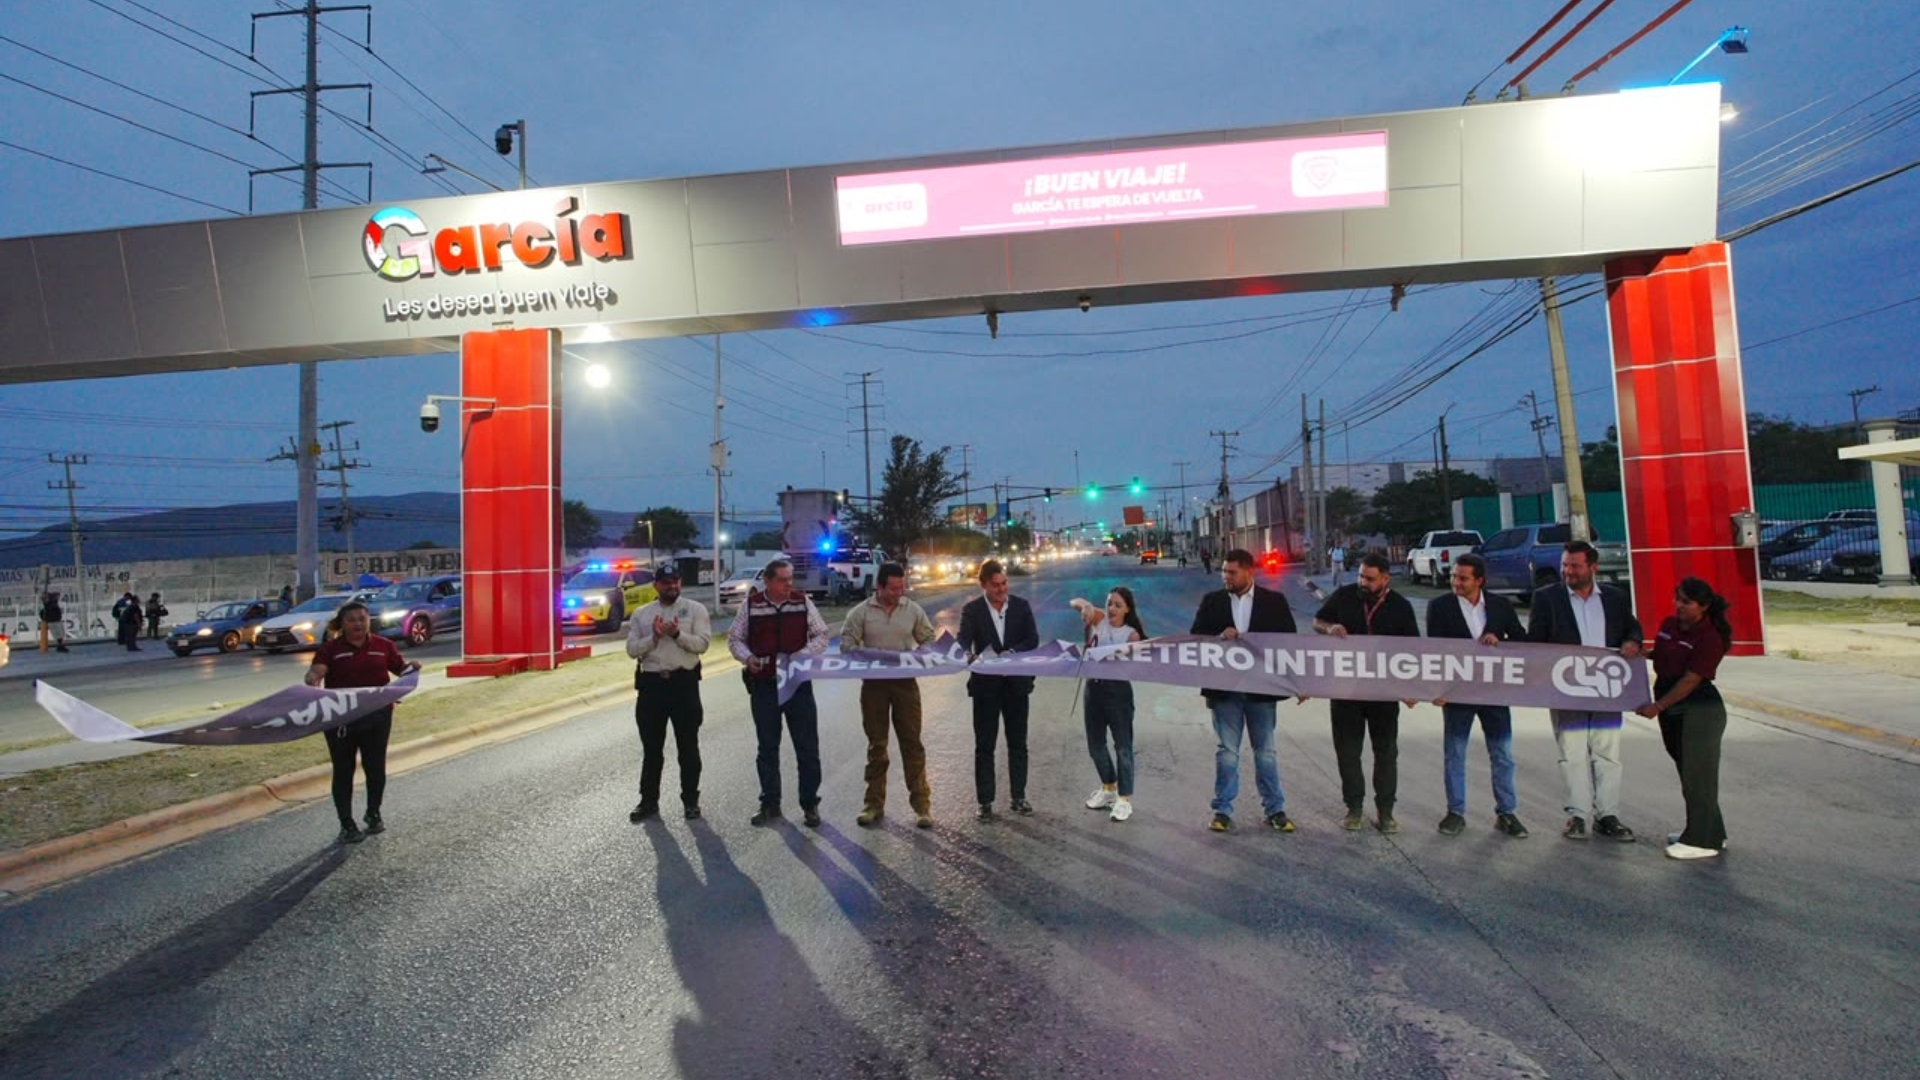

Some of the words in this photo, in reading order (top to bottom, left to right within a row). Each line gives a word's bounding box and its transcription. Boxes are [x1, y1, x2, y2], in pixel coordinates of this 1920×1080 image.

[1025, 170, 1100, 196] ¡BUEN
[1104, 162, 1187, 189] VIAJE!
[1066, 198, 1081, 211] TE
[1083, 194, 1131, 209] ESPERA
[1134, 192, 1150, 205] DE
[1151, 188, 1203, 203] VUELTA
[363, 196, 626, 280] García
[384, 298, 422, 317] Les
[427, 294, 495, 313] desea
[499, 287, 551, 308] buen
[558, 282, 610, 306] viaje
[334, 553, 461, 575] CERRAJE
[821, 658, 888, 672] DEL
[1264, 648, 1525, 686] INTELIGENTE
